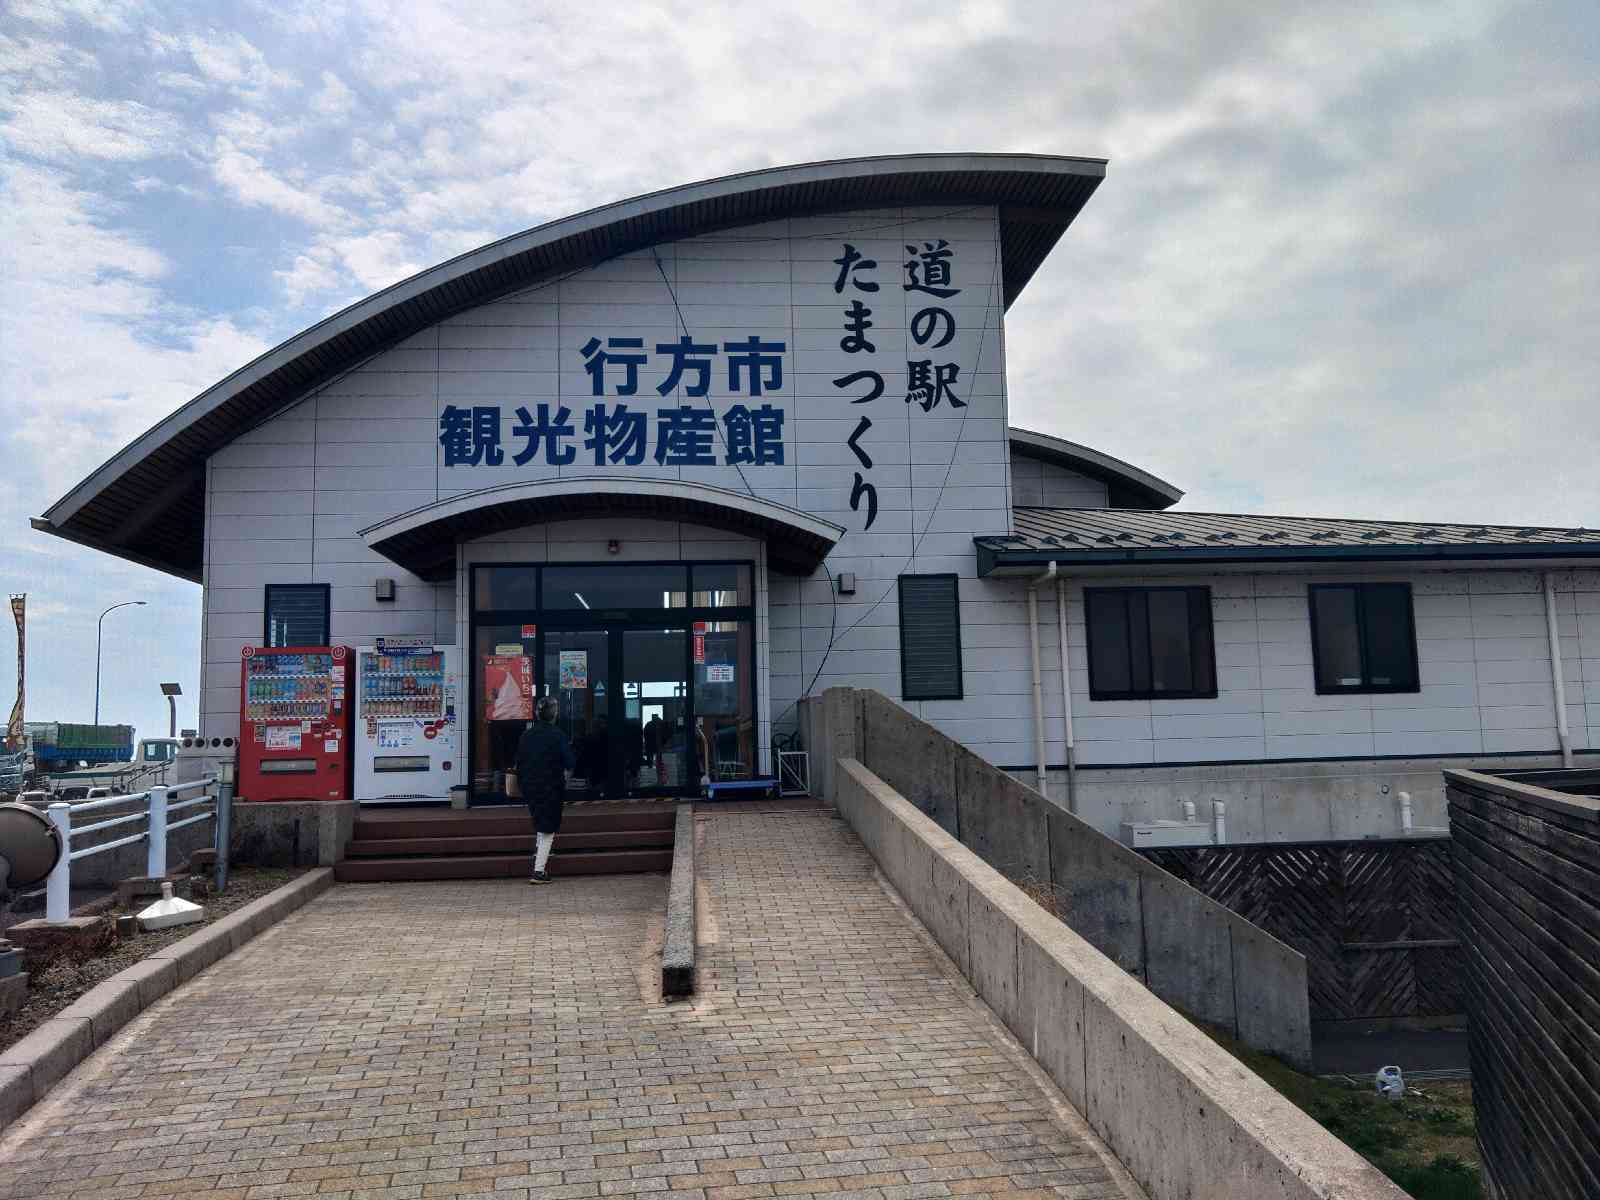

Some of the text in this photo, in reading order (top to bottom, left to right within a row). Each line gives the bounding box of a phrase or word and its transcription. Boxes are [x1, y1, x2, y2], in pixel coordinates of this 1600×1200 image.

[580, 335, 786, 397] 行方市
[903, 239, 967, 412] 道の駅
[439, 403, 785, 467] 観光物産館
[833, 244, 885, 531] たまつくり
